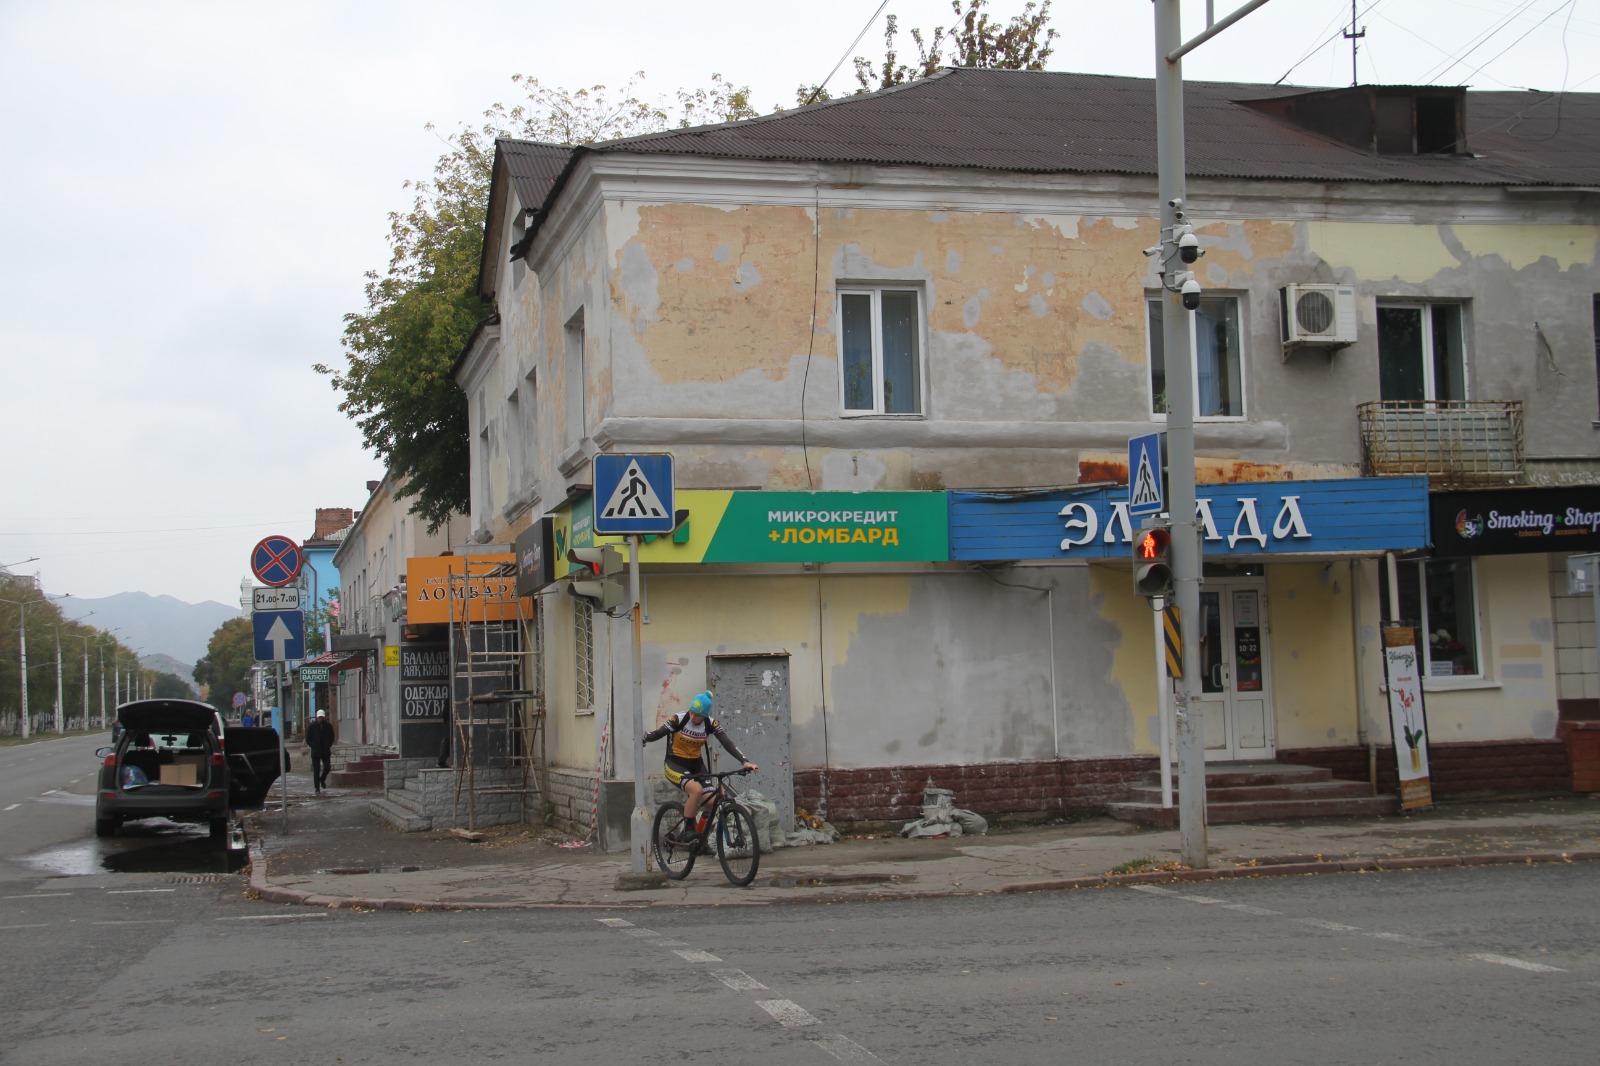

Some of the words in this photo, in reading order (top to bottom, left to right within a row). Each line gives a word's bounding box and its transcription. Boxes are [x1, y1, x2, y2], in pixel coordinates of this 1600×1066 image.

[767, 510, 899, 525] МИКРОКРЕДИТ
[1057, 495, 1312, 550] ЭЛАДА
[1487, 510, 1554, 535] Smoking
[1564, 507, 1600, 533] Shop
[768, 527, 899, 546] +ЛОМБАРД
[403, 651, 449, 665] БАЛАЛАР
[404, 685, 449, 700] ОДЕЖДА
